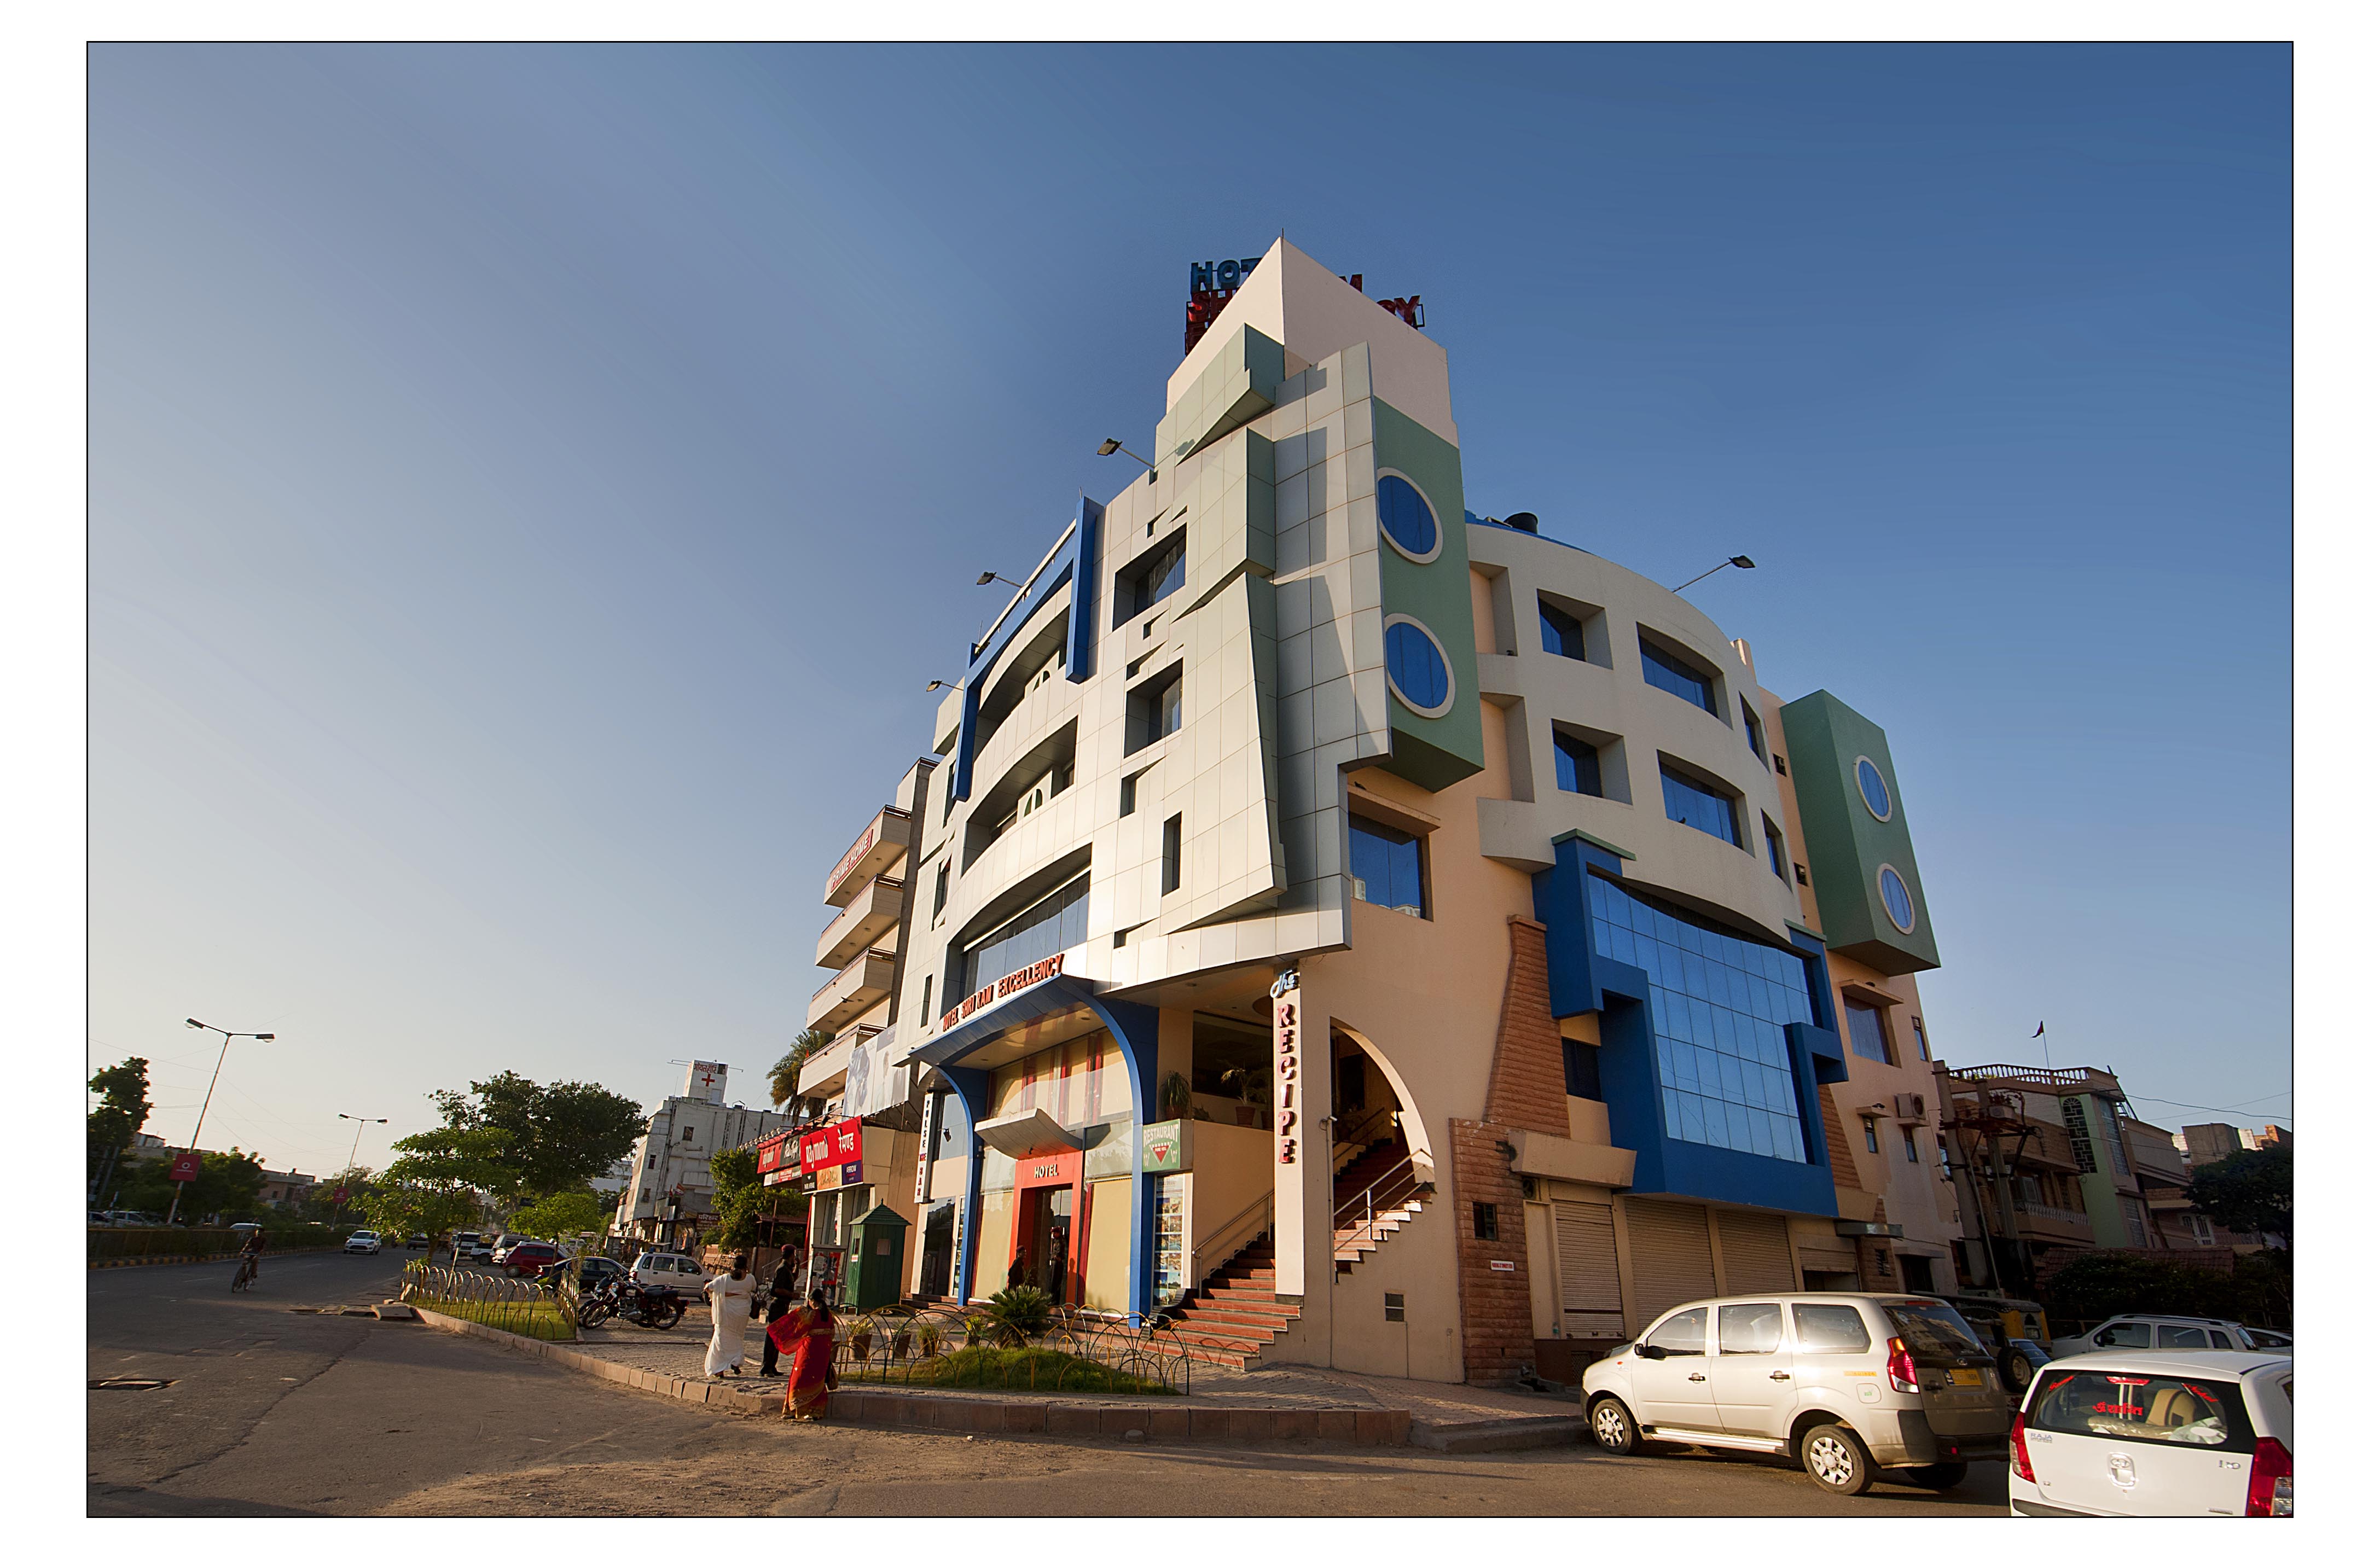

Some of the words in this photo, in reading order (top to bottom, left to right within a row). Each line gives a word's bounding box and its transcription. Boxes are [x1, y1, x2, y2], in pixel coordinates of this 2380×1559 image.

[832, 857, 851, 888] PRIME
[850, 835, 870, 866] HOME
[943, 1008, 959, 1032] HOTEL
[961, 995, 977, 1019] SHRI
[977, 985, 994, 1009] RAM
[998, 953, 1065, 998] EXCELLENCY
[1270, 969, 1295, 998] The
[1278, 1004, 1297, 1164] RECIPE
[806, 1135, 828, 1168] Raymond
[838, 1128, 855, 1154] रेमण्ड
[1143, 1124, 1179, 1147] RESTAURANT
[1034, 1164, 1059, 1178] HOTEL
